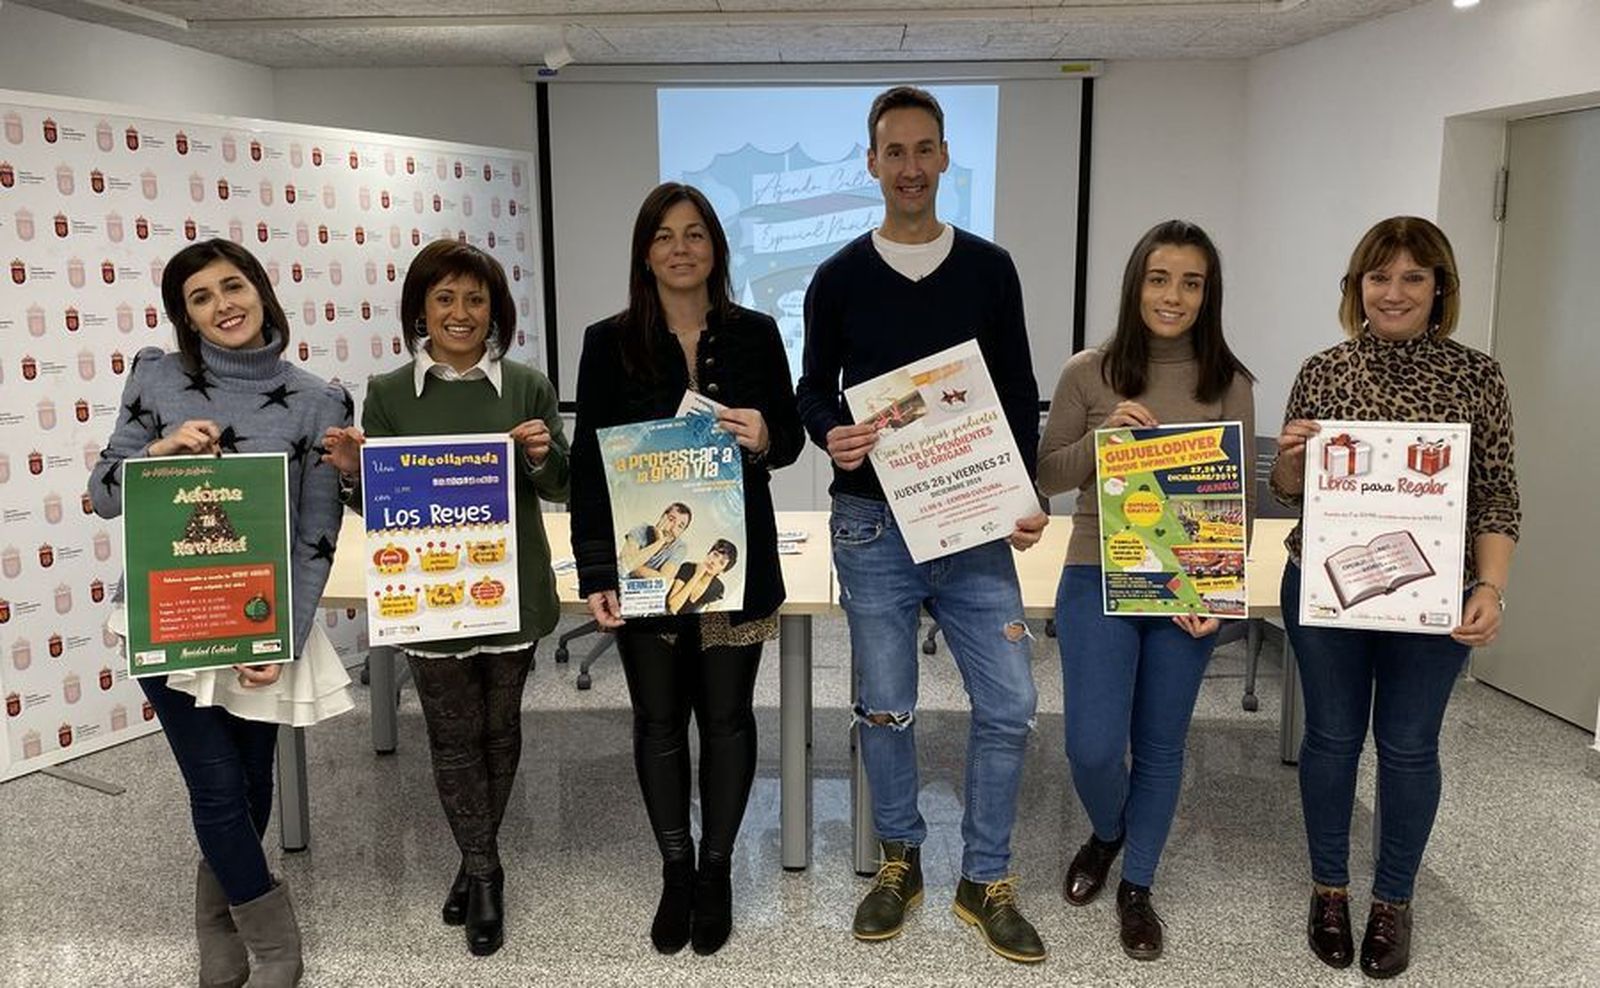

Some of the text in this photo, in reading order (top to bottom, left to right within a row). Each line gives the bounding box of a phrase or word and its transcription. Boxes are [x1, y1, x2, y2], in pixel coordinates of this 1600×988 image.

[401, 452, 498, 467] Videollamada
[629, 446, 718, 469] protestar
[722, 447, 733, 463] a
[888, 426, 994, 469] TALLER DE PENDIENTES
[916, 445, 973, 470] DE ORIGAMI
[1105, 435, 1216, 463] GUIJUELODIVER
[894, 480, 931, 501] JUEVES
[931, 476, 945, 488] 26
[952, 459, 997, 481] VIERNES
[996, 452, 1011, 465] 27
[1107, 461, 1138, 473] PARQUE
[1139, 456, 1177, 469] INFANTIL
[1318, 475, 1448, 498] Libros para Regalar
[384, 503, 492, 527] Los Reyes
